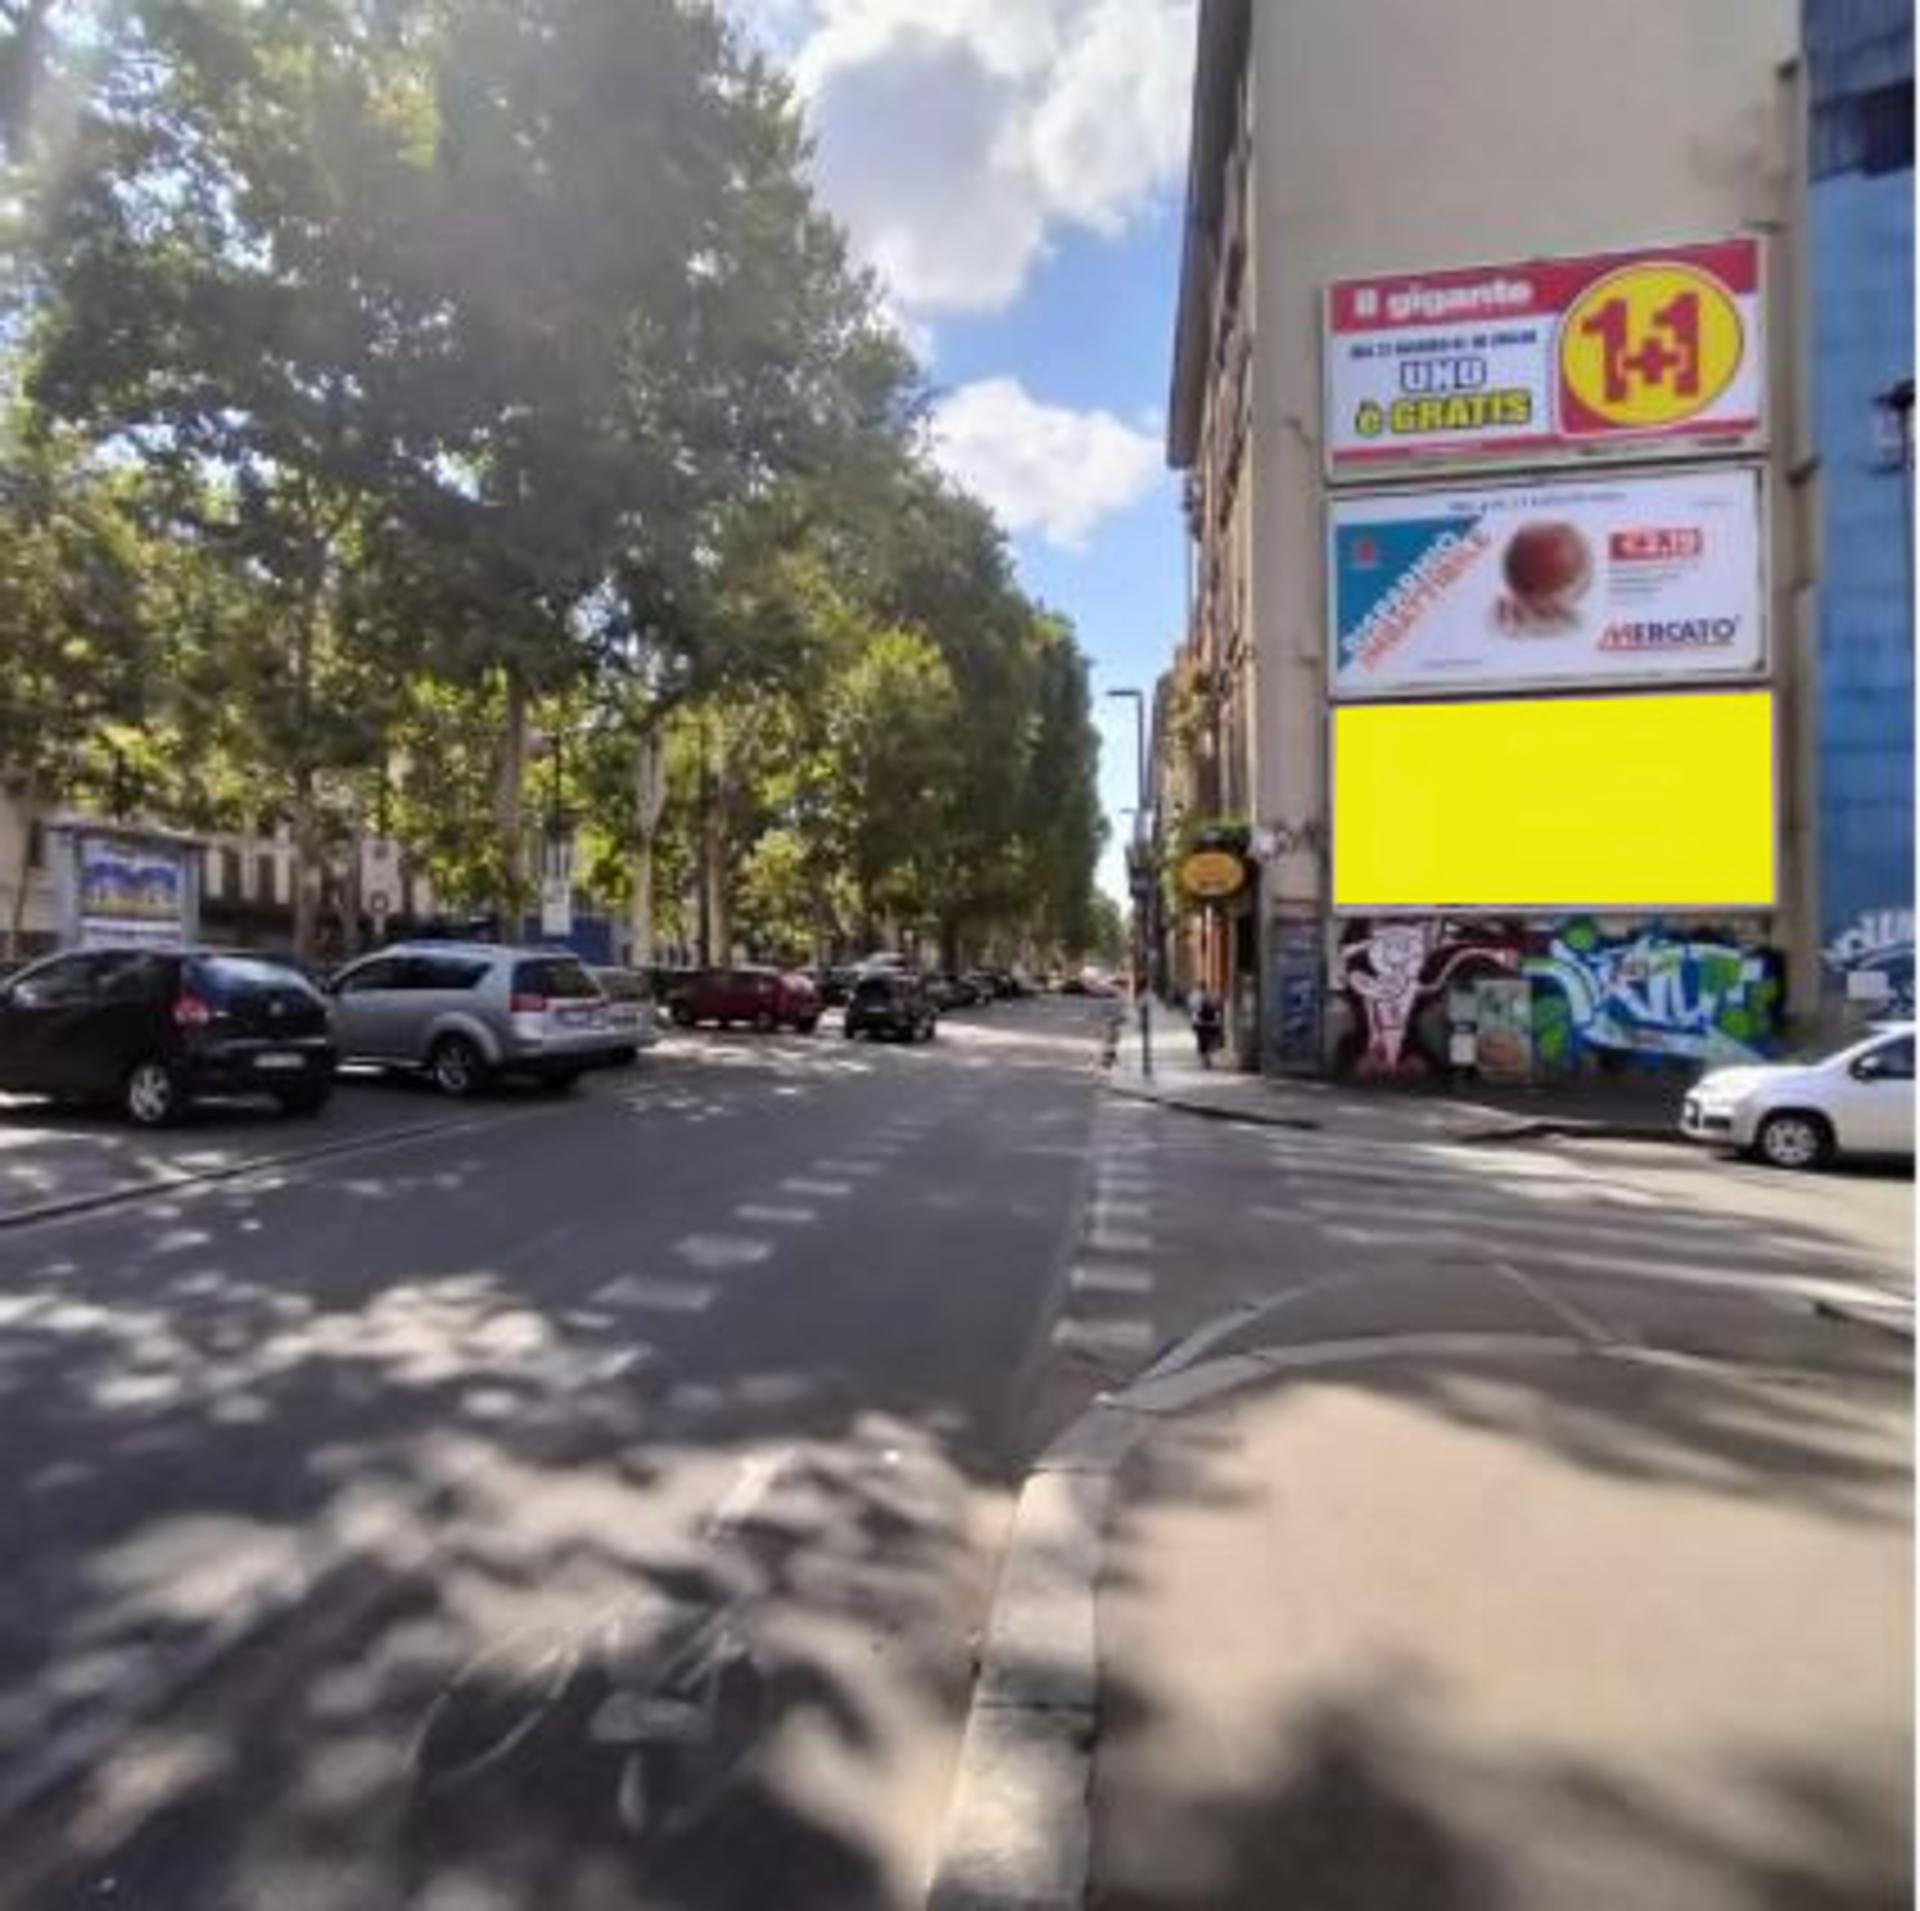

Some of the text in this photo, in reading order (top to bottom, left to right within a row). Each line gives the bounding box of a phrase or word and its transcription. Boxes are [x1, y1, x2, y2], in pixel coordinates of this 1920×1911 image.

[1387, 279, 1534, 321] gigante
[1581, 291, 1699, 402] 1+1
[1391, 388, 1532, 434] GRATIS
[1600, 618, 1736, 649] MERCATO
